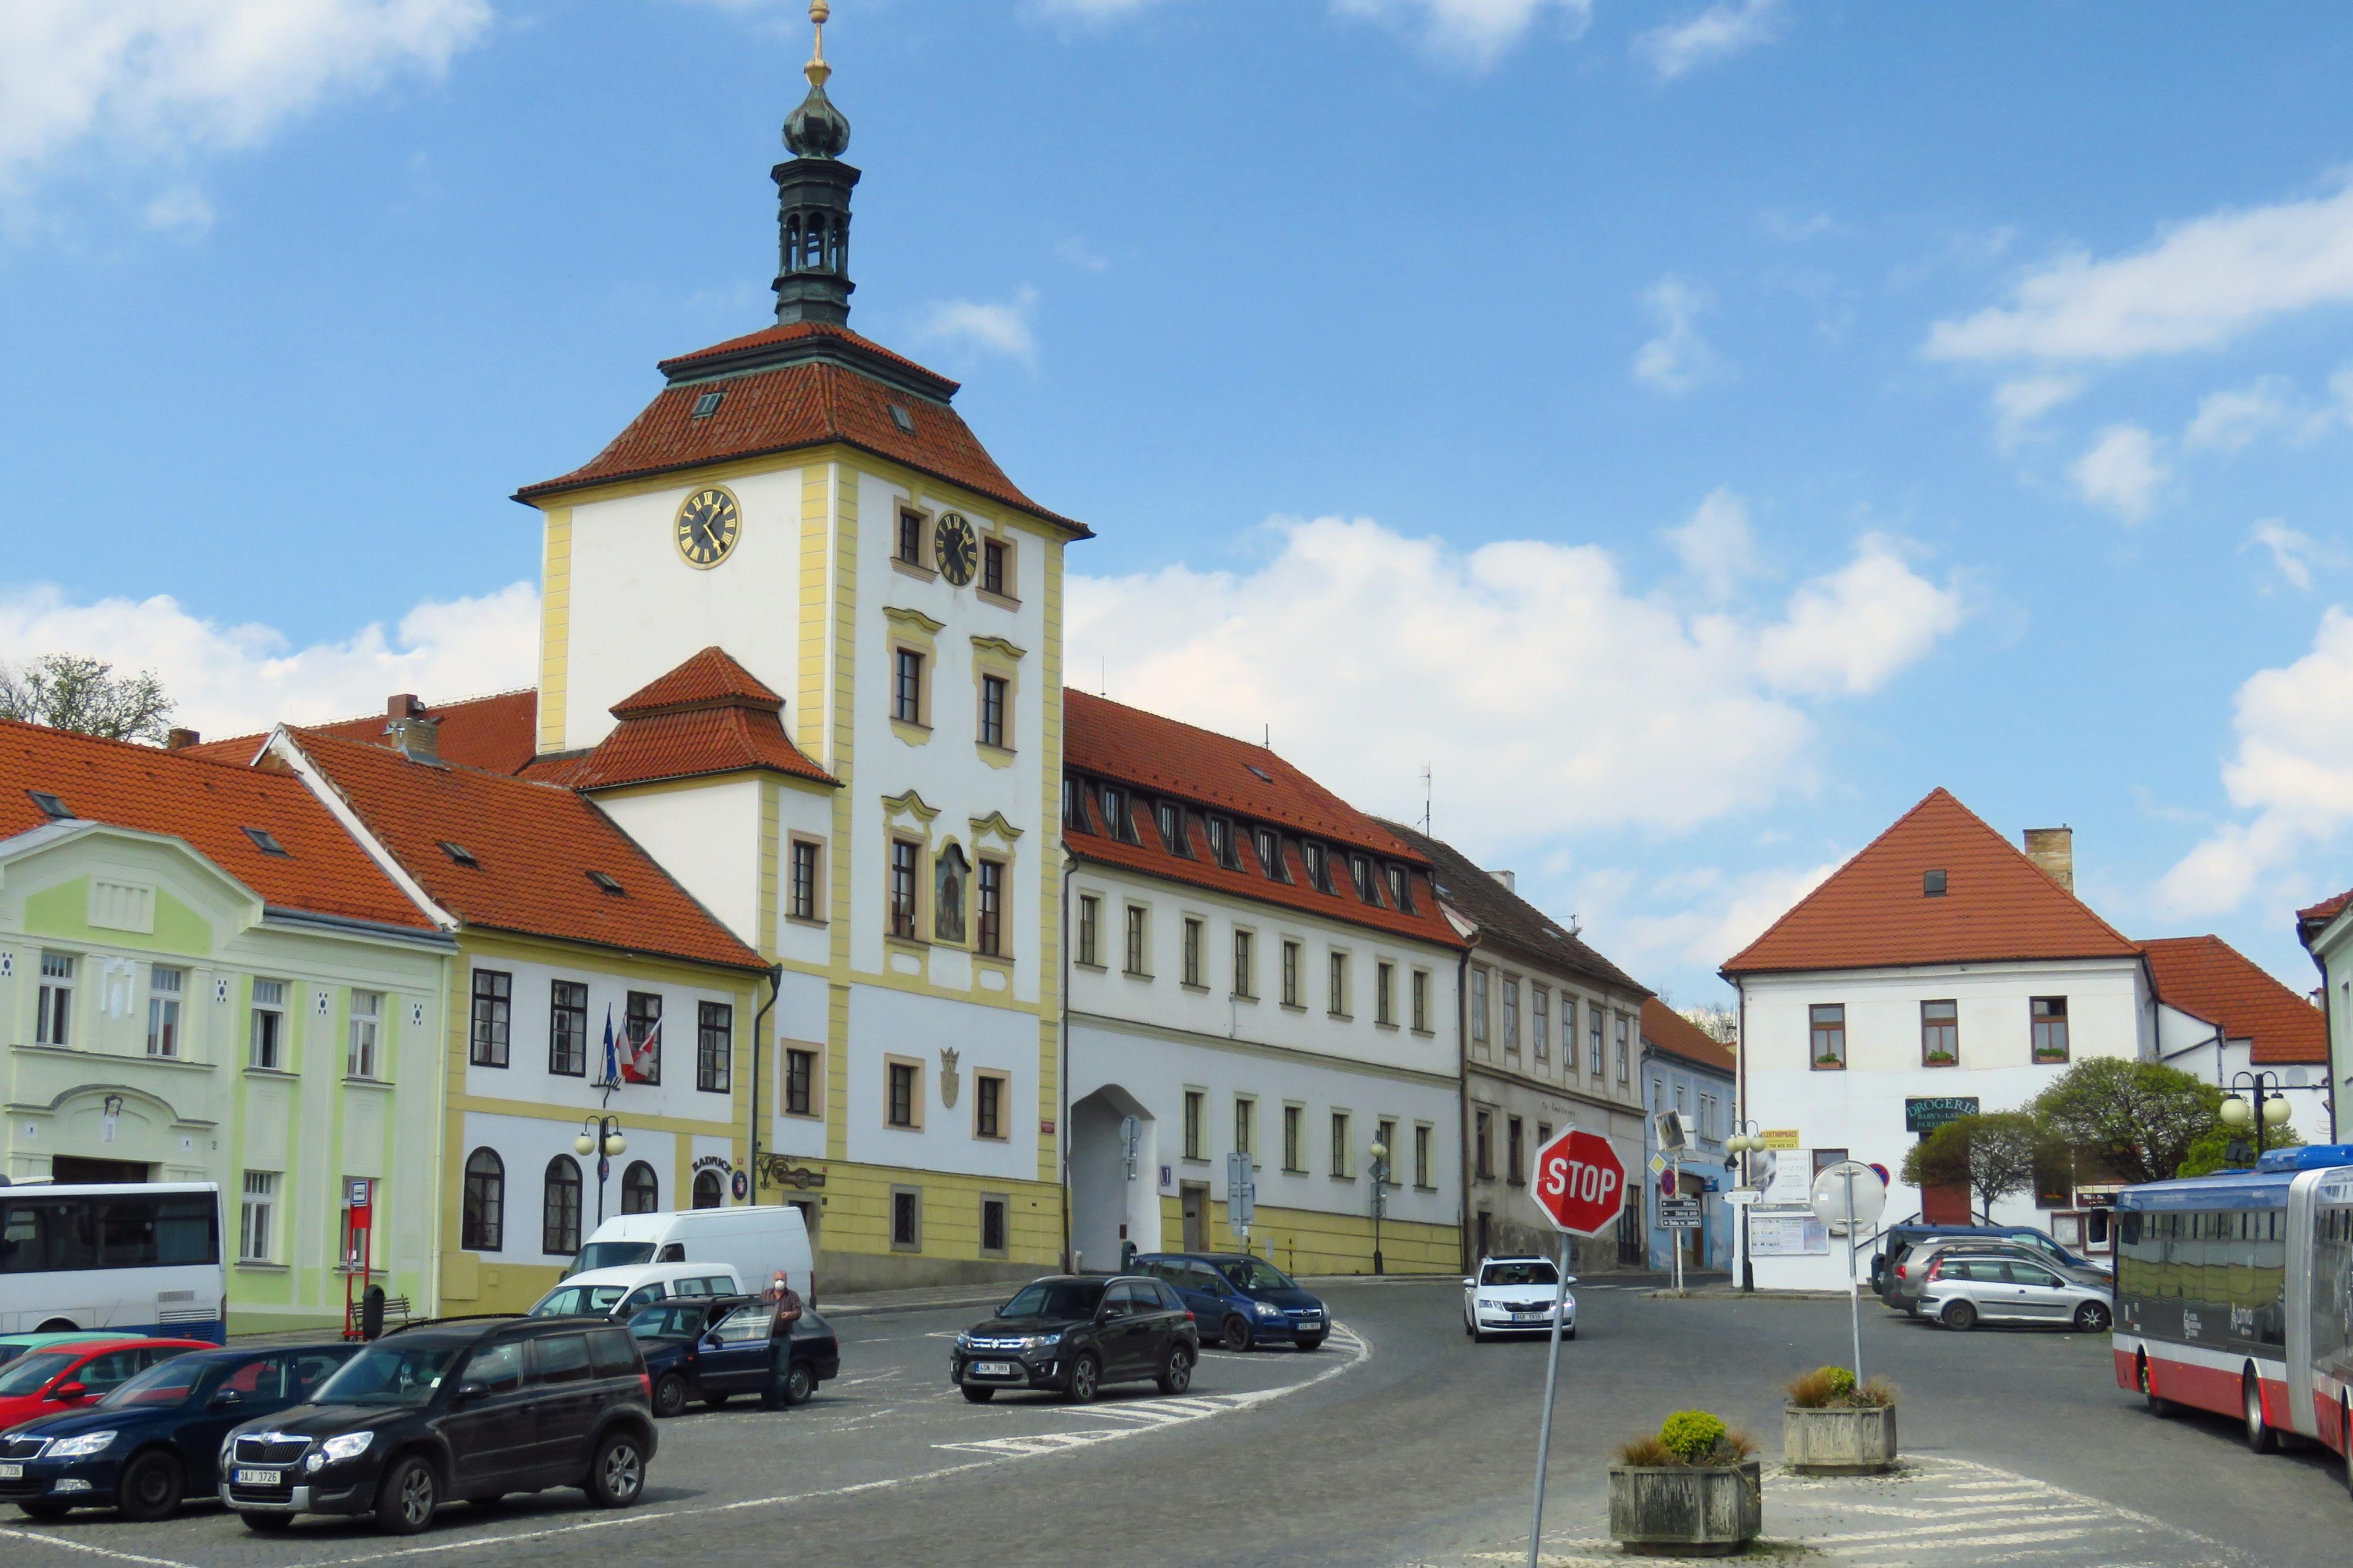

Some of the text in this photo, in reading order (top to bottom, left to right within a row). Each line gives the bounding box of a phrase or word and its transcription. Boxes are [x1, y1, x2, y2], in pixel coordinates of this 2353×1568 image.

[704, 491, 713, 506] XII
[1907, 1098, 1978, 1117] DROGERIE
[212, 1140, 217, 1150] 2
[692, 1156, 732, 1175] RADNICE
[1547, 1157, 1616, 1205] STOP
[240, 1471, 277, 1482] 3AJ 3726
